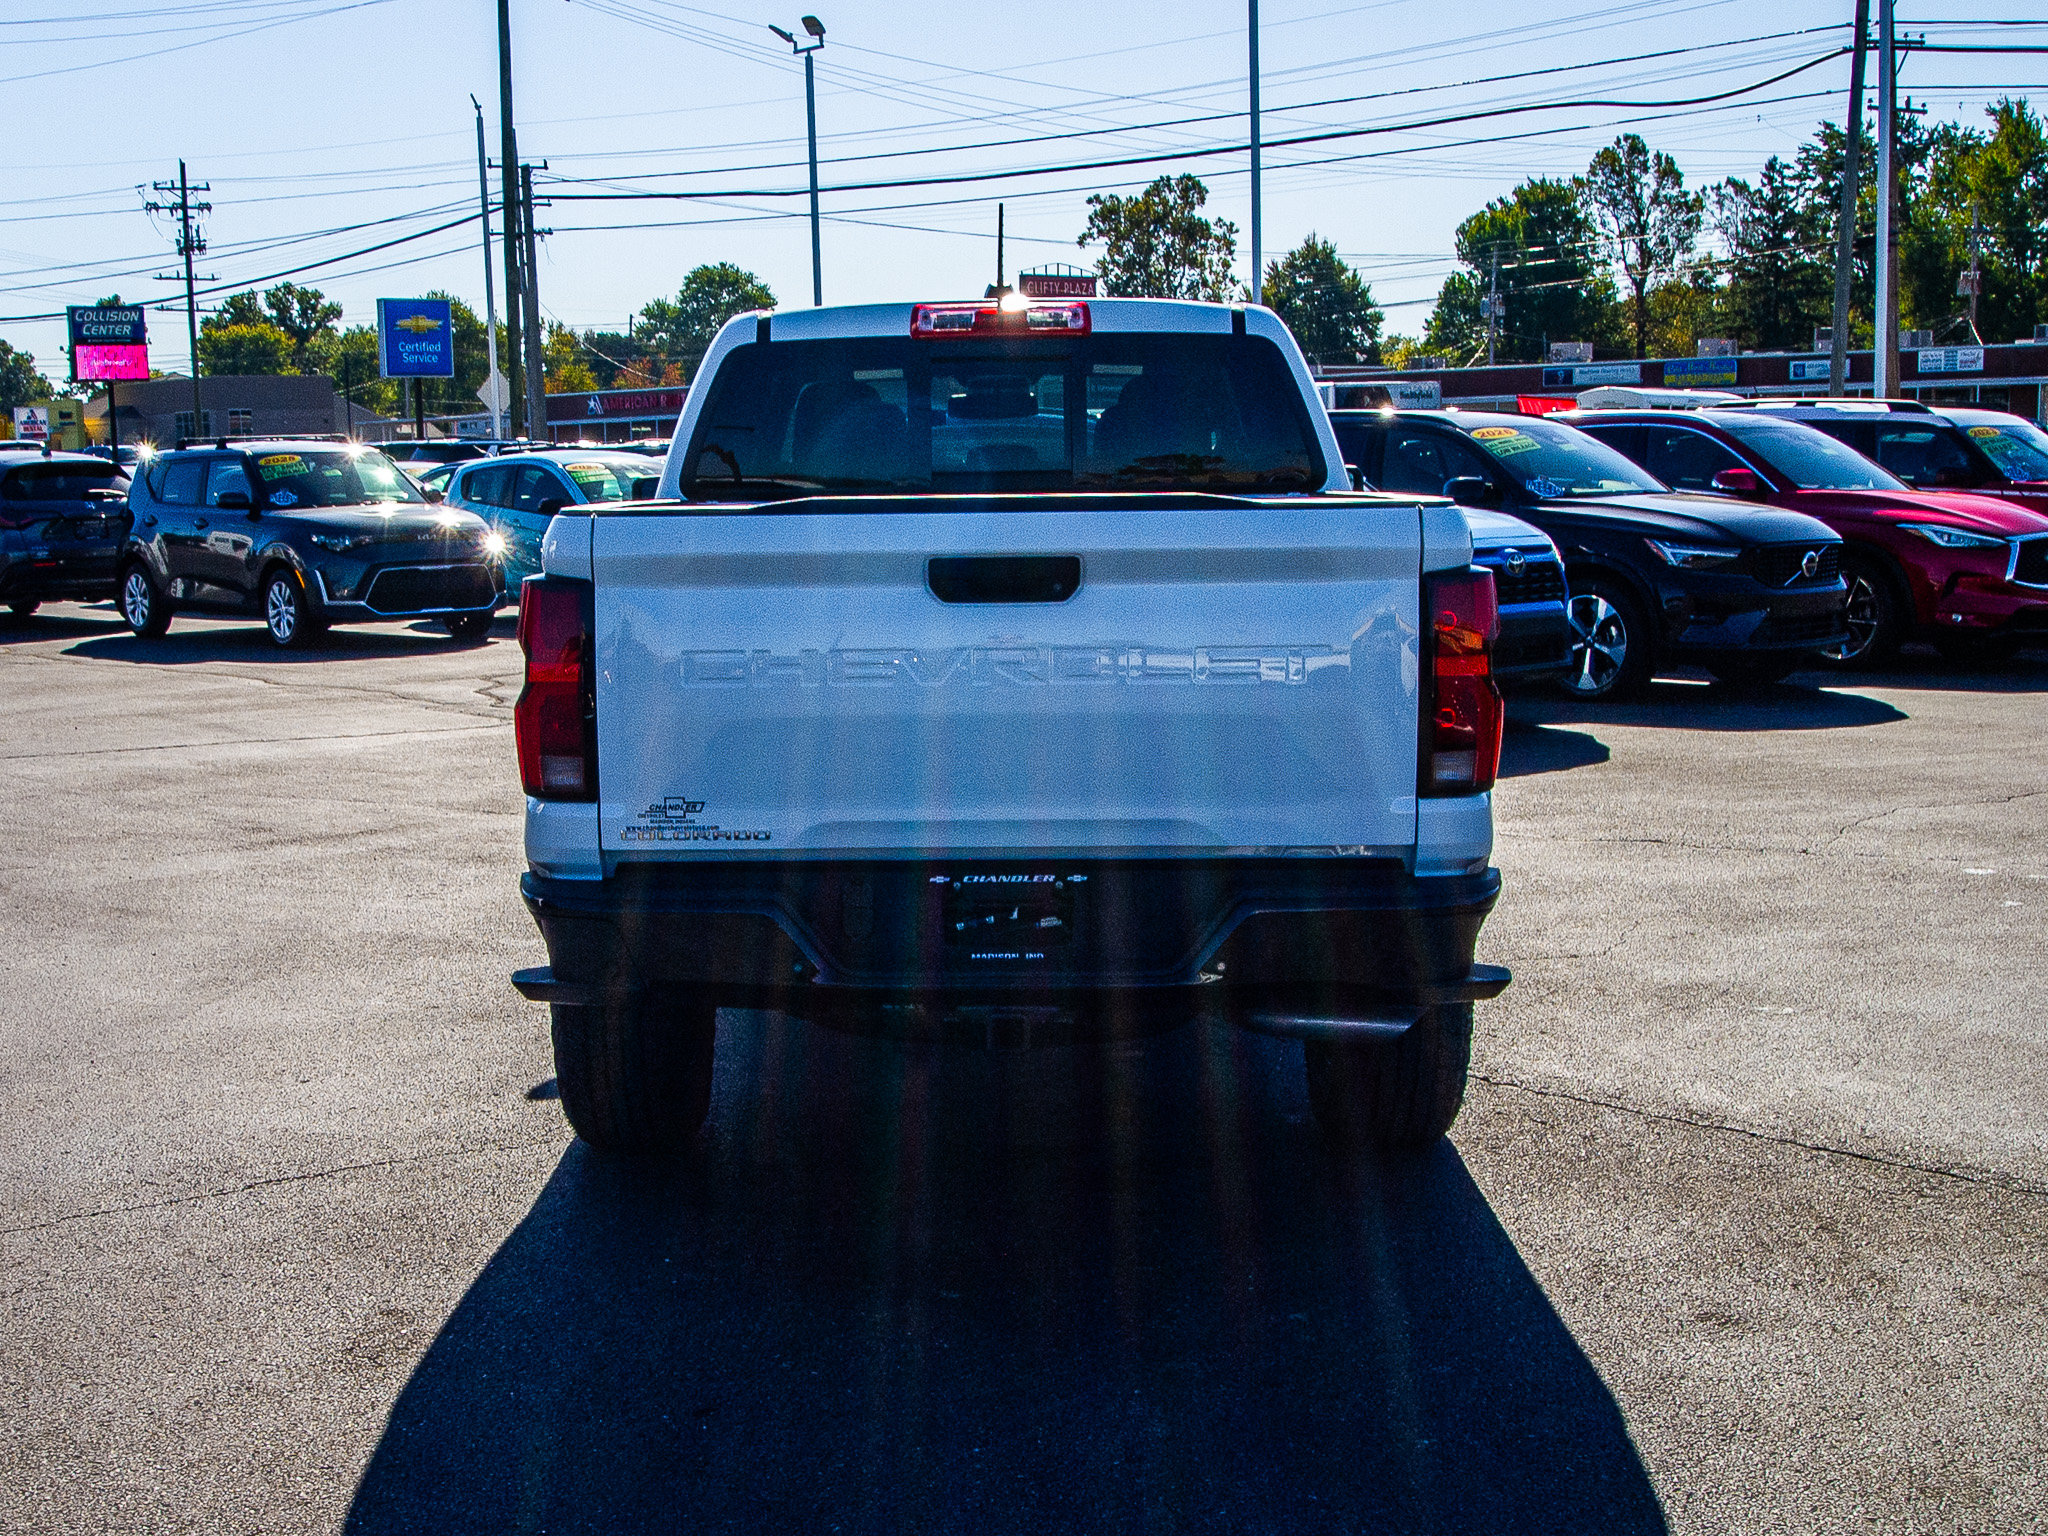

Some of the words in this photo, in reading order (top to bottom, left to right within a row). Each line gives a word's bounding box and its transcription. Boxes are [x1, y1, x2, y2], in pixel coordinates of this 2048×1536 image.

[1027, 281, 1060, 294] CLIFTY
[1064, 282, 1095, 295] PLAZA
[75, 309, 139, 322] COLLISION
[82, 323, 132, 336] CENTER
[398, 341, 441, 353] Certified
[402, 353, 439, 364] Service
[603, 394, 658, 410] AMERICAN
[679, 646, 1331, 686] CHEVROLET
[649, 803, 698, 812] CHANDLER
[620, 830, 771, 841] COLORADO
[963, 875, 1056, 883] CHANDLER
